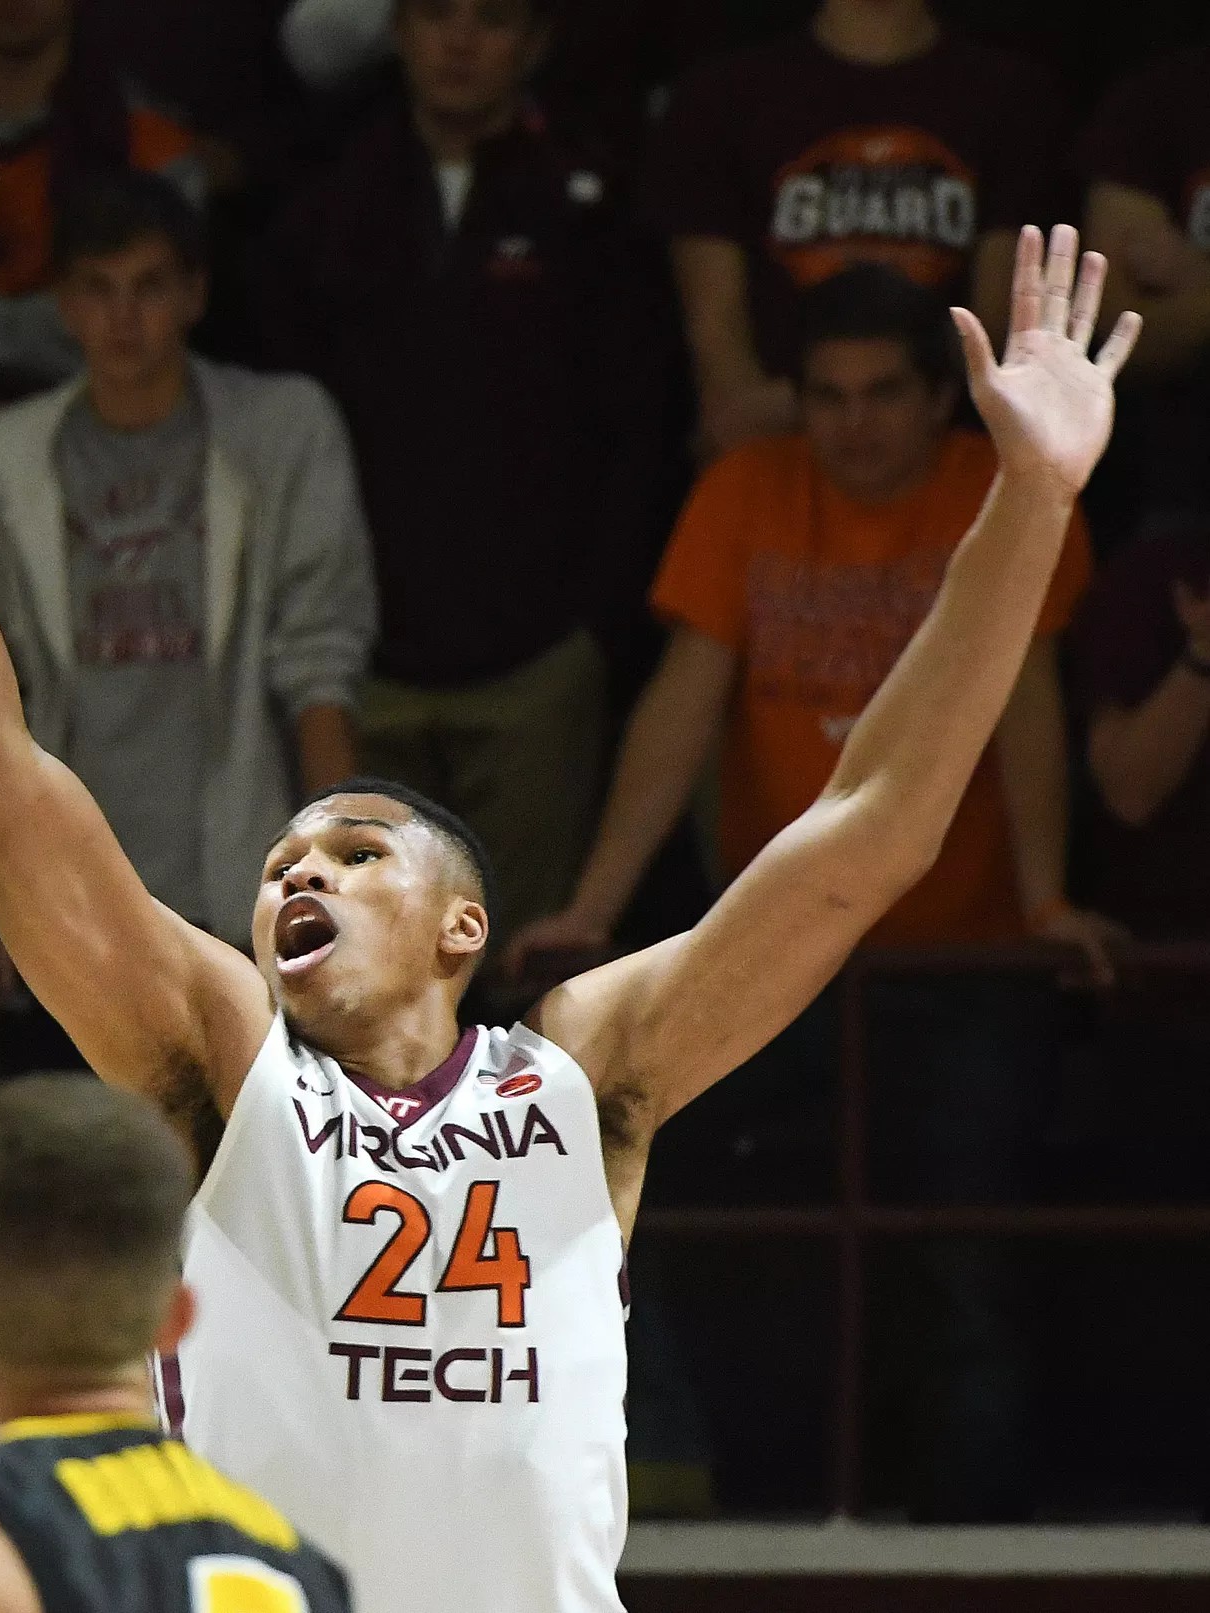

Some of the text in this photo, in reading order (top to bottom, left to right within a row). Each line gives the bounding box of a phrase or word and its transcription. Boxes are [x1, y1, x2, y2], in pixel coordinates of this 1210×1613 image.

[292, 1097, 567, 1171] VIRGINIA
[333, 1180, 531, 1328] 24
[329, 1342, 539, 1403] TECH
